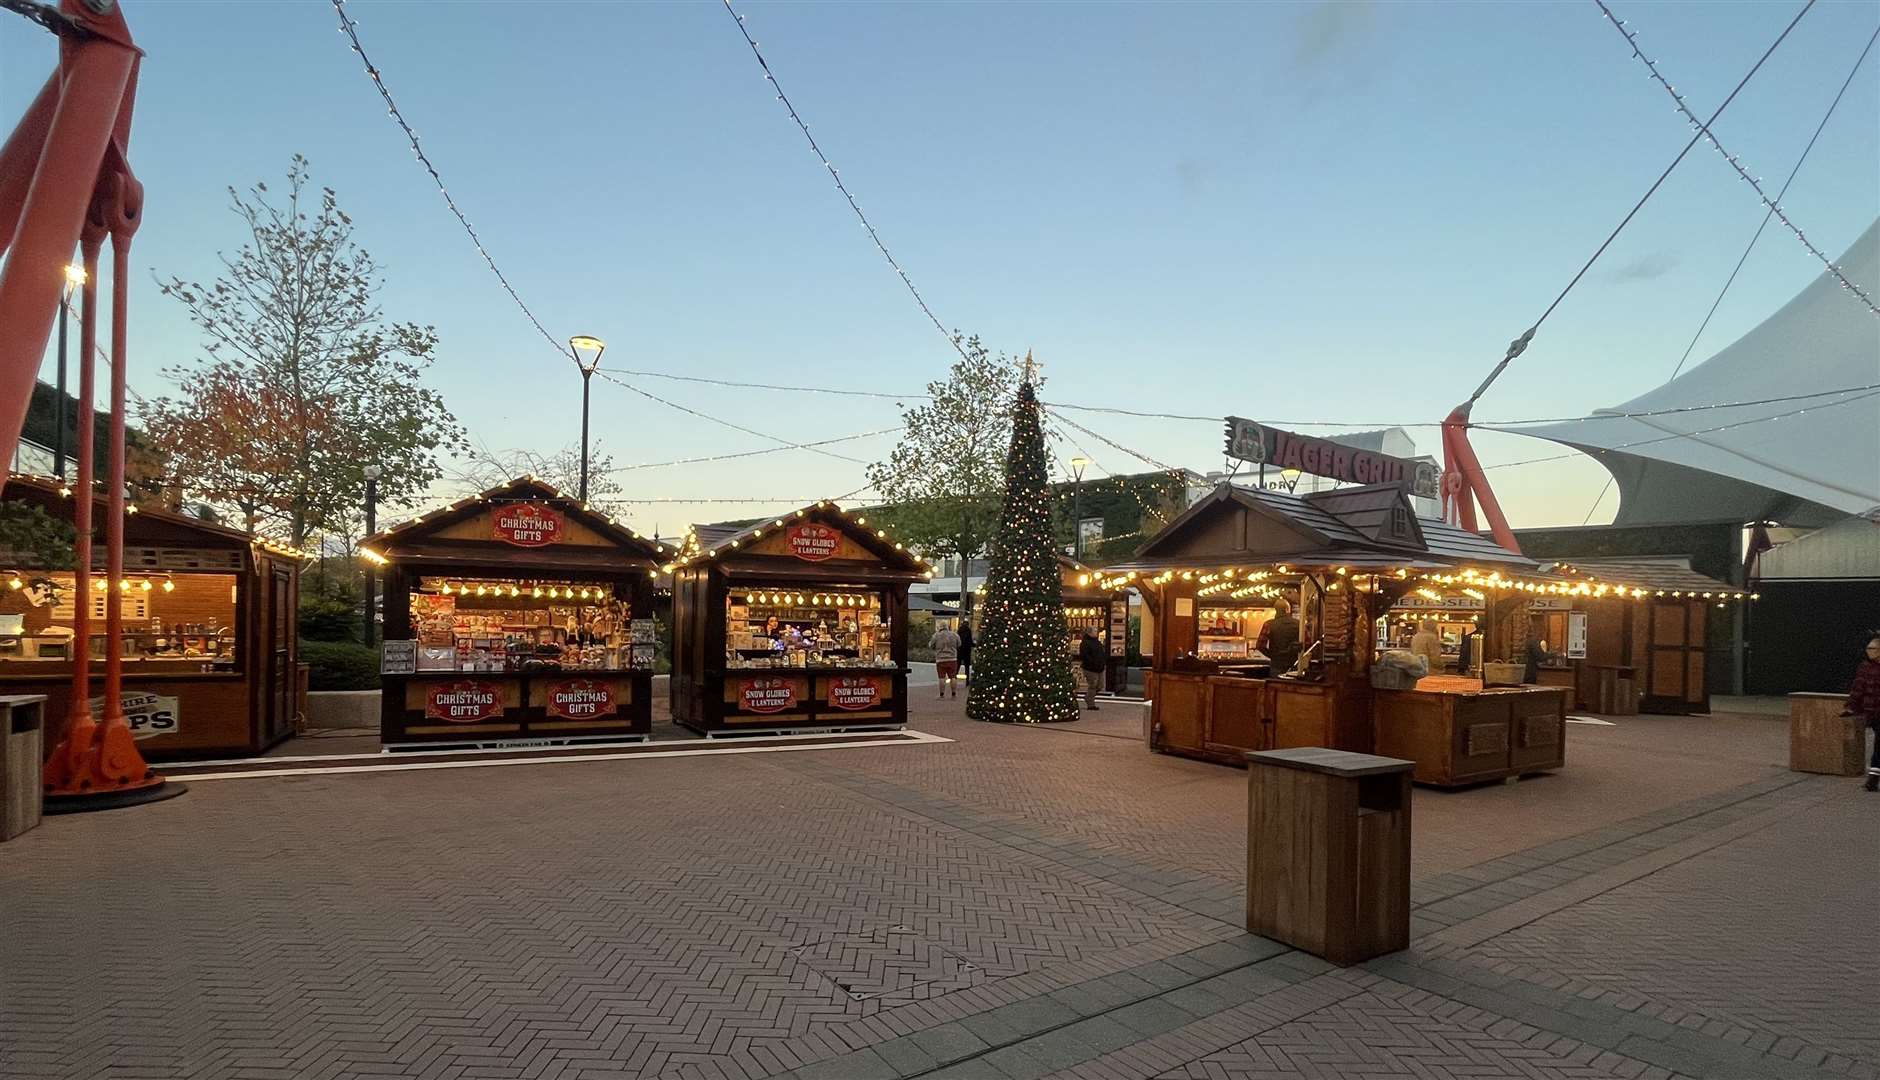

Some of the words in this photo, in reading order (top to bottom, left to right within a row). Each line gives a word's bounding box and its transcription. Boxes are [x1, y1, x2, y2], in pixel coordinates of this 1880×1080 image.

[500, 517, 554, 531] CHRISTMAS
[514, 529, 542, 542] GIFTS
[792, 536, 811, 546] SNOW
[812, 538, 836, 548] GLOBES
[803, 547, 830, 555] LANTERNS
[1413, 598, 1482, 607] DESSER
[745, 690, 765, 699] SNOW
[766, 688, 791, 698] GLOBES
[834, 687, 852, 696] SNOW
[853, 687, 875, 696] GLOBES
[436, 693, 493, 705] CHRISTMAS
[556, 691, 607, 704] CHRISTMAS
[757, 698, 785, 706] LANTERNS
[844, 696, 870, 704] LANTERNS
[450, 705, 480, 716] GIFTS
[569, 703, 595, 714] GIFTS
